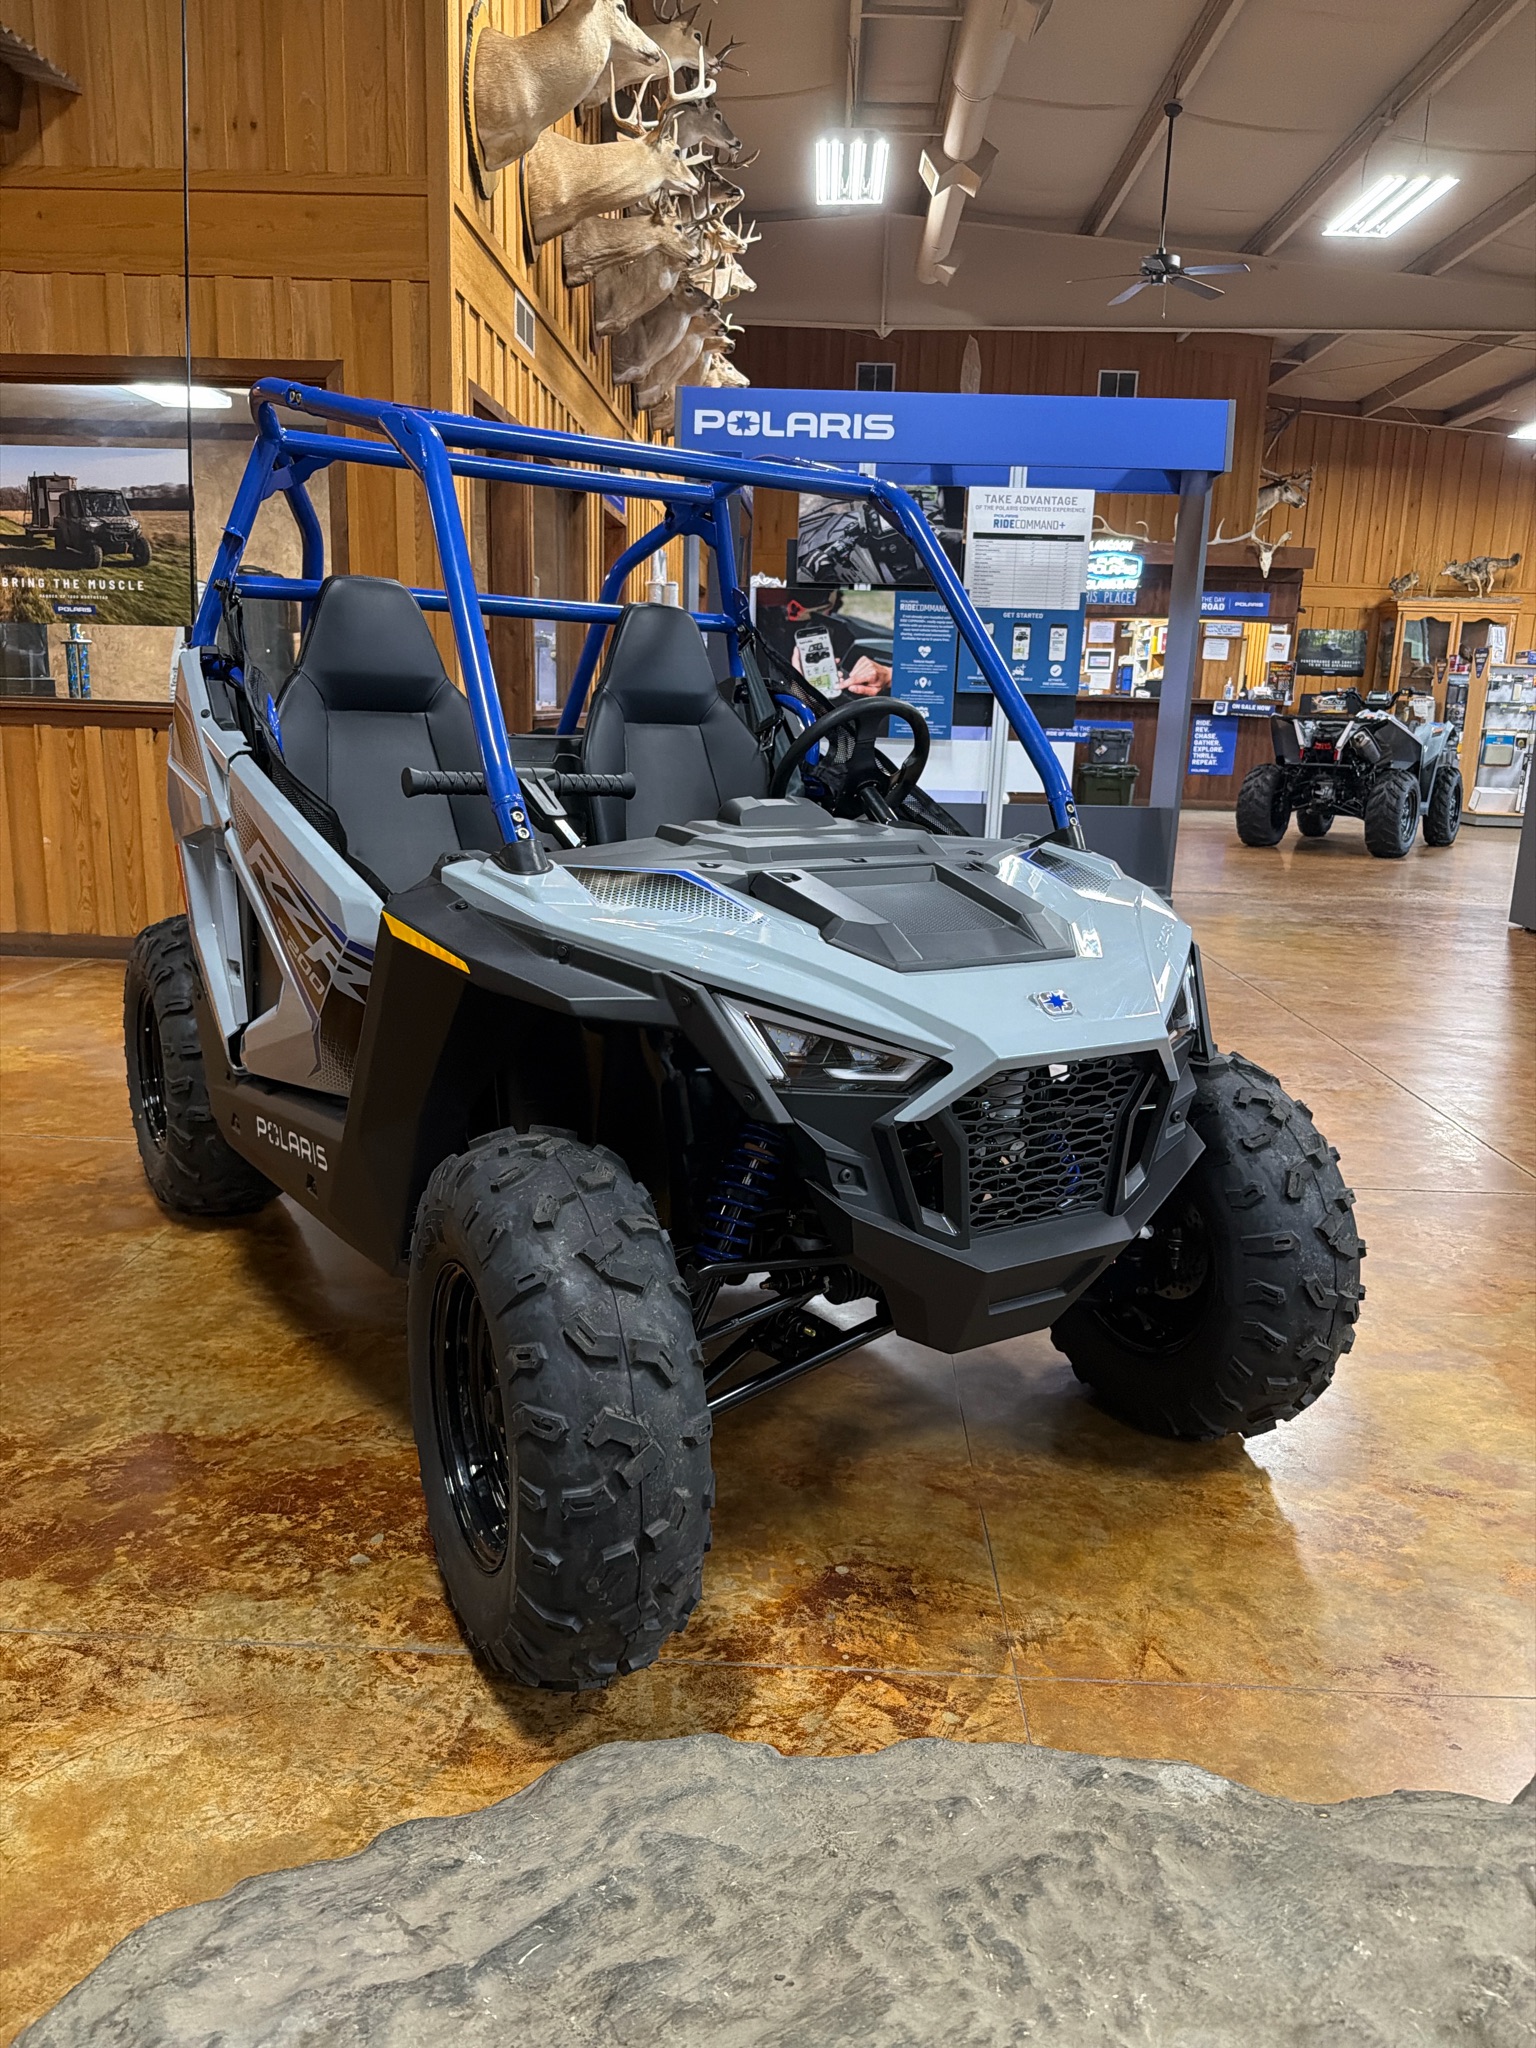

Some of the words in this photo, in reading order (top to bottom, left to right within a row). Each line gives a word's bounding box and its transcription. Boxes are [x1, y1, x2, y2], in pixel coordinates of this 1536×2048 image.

[694, 409, 896, 440] POLARIS
[985, 494, 1012, 504] TAKE
[1015, 495, 1078, 506] ADVANTAGE
[1, 577, 45, 588] BRING
[53, 578, 80, 589] THE
[88, 580, 145, 591] MUSCLE
[1104, 592, 1131, 603] PLACE
[246, 838, 372, 1005] RZR
[287, 935, 325, 995] 200
[256, 1115, 328, 1172] POLARIS
